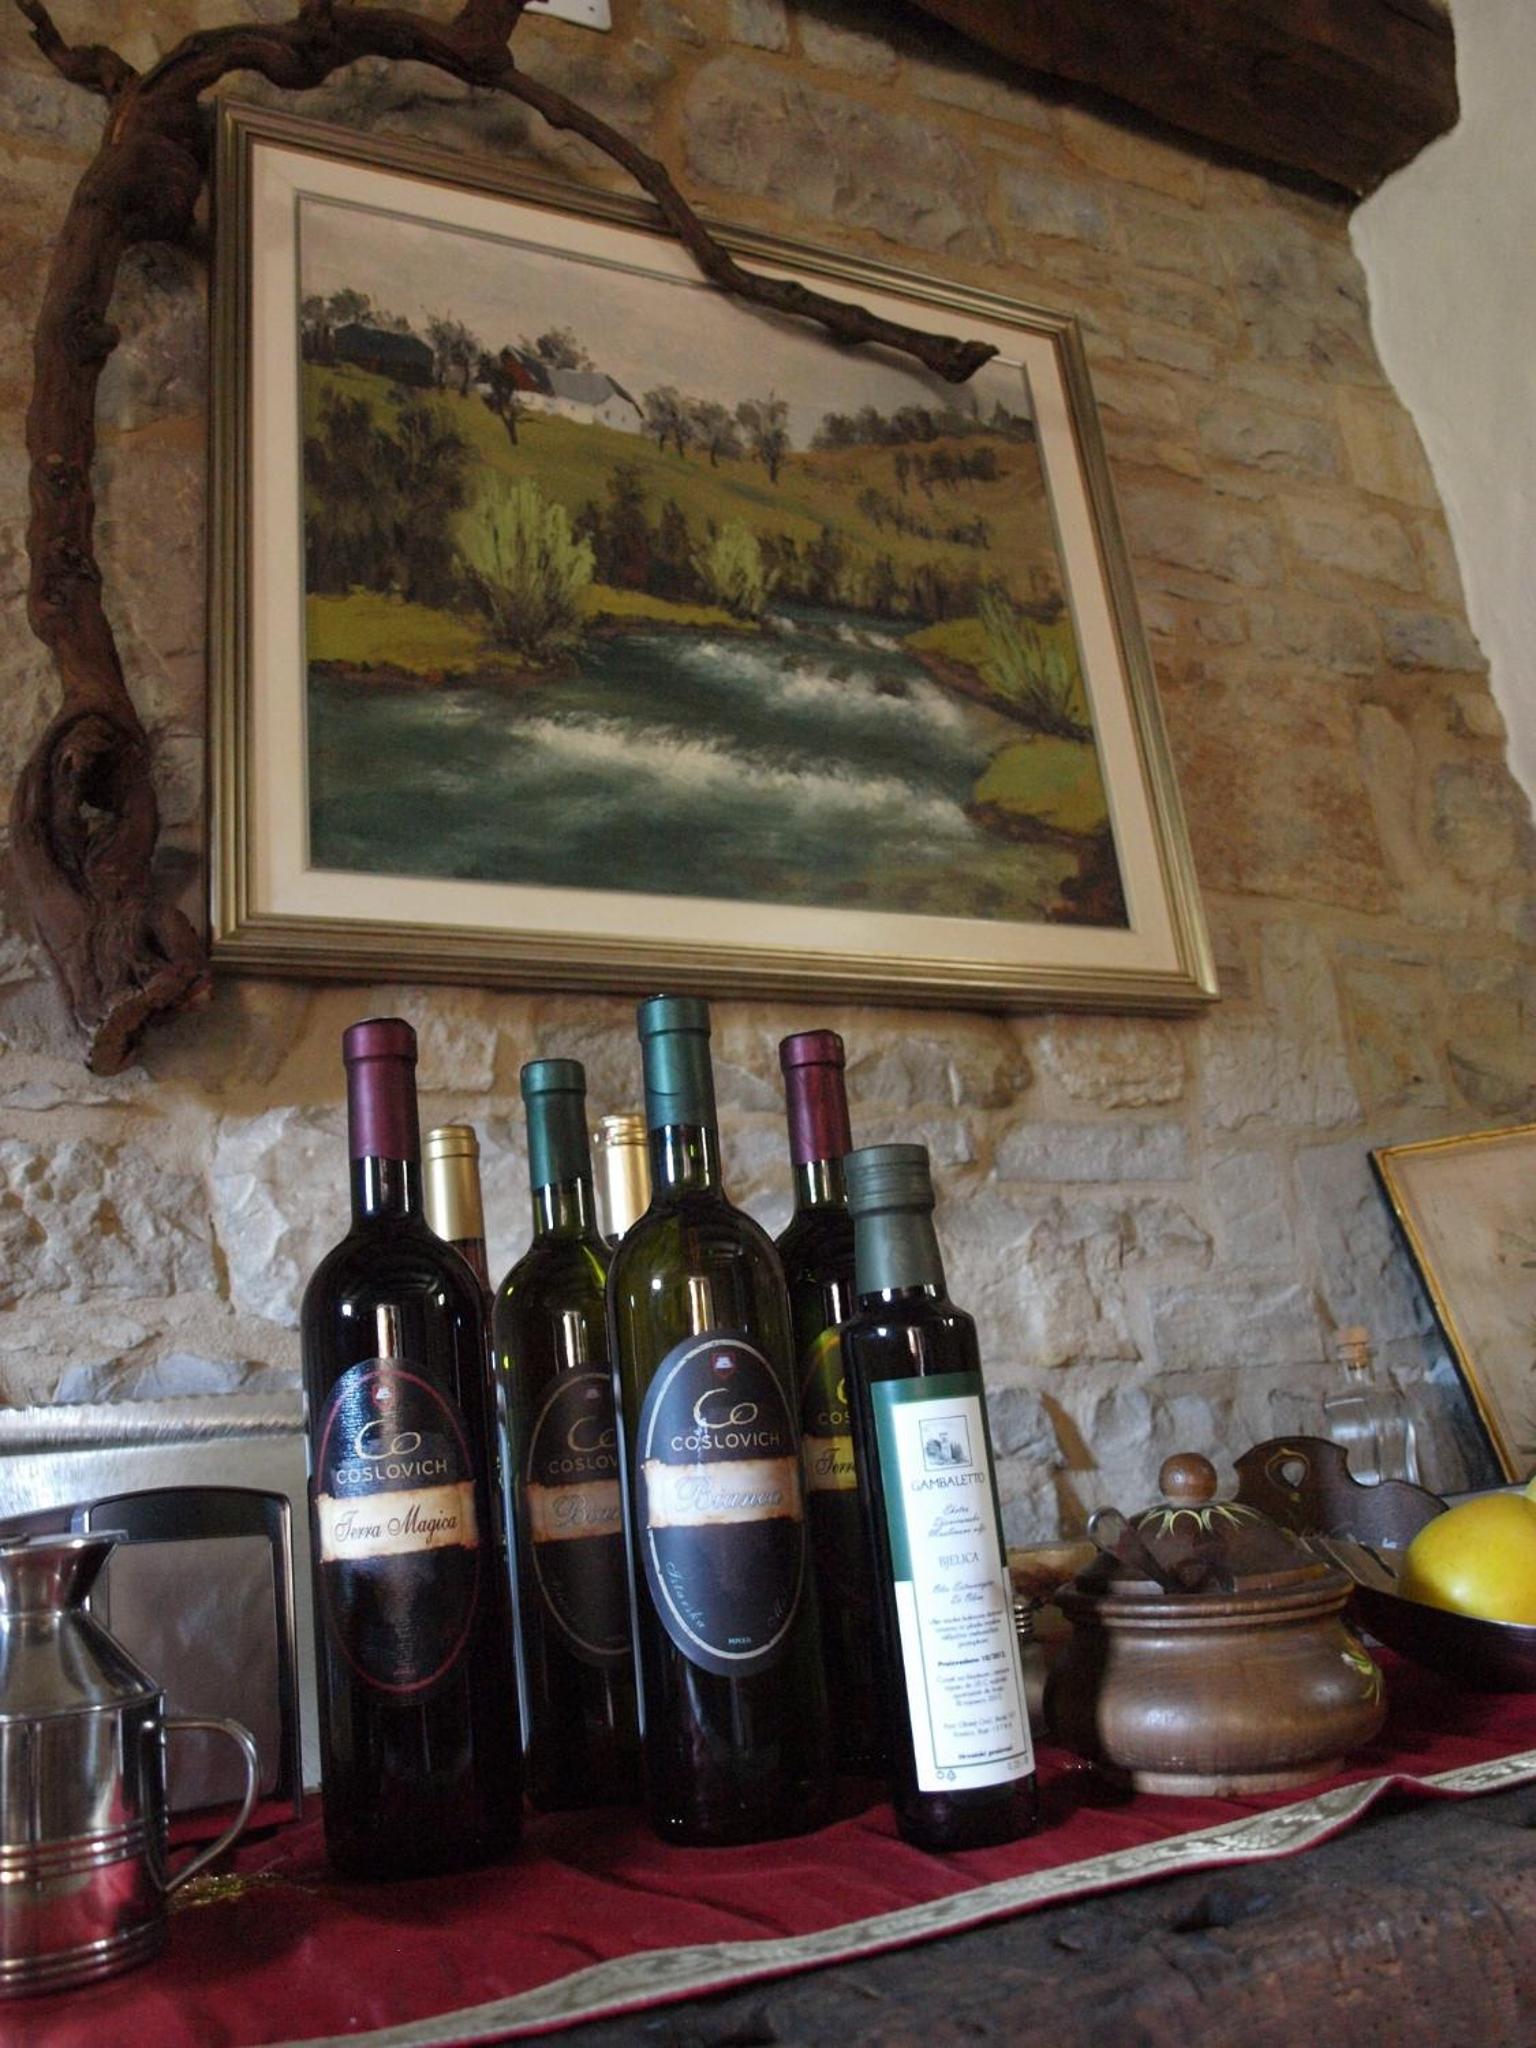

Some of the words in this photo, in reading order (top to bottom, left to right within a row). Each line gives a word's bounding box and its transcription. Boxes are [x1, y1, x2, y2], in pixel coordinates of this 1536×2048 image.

[671, 1432, 780, 1452] COSLOVICH
[336, 1459, 448, 1485] COSLOVICH
[548, 1455, 617, 1474] COSLOV
[815, 1446, 854, 1475] Terr
[911, 1472, 985, 1491] GAMBALETTO
[334, 1510, 382, 1542] Terra
[387, 1503, 458, 1545] Magica
